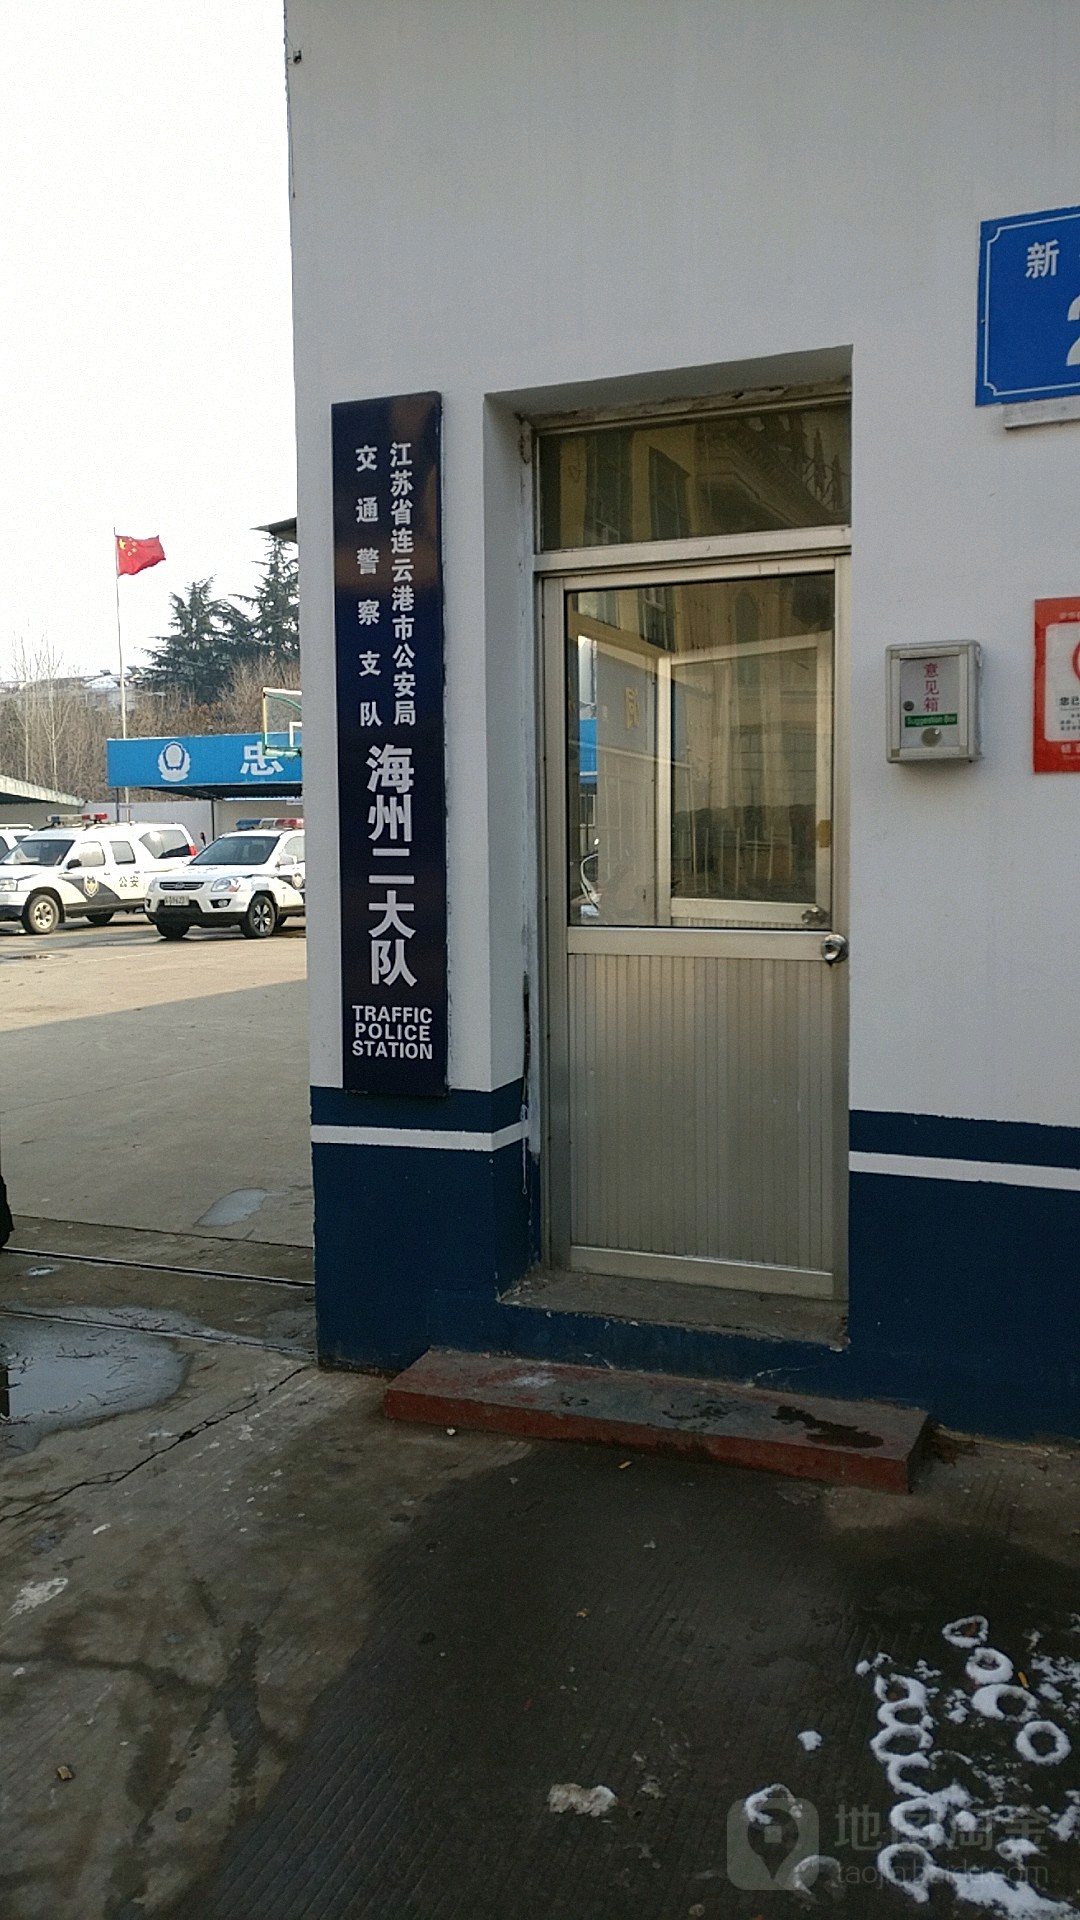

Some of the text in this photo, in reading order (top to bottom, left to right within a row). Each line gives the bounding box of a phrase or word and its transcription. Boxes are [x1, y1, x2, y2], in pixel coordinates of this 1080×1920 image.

[1025, 239, 1060, 279] 新
[355, 445, 383, 728] 交通警察支队
[390, 441, 416, 727] 江苏省连云港市公安局
[923, 662, 940, 713] 意见箱
[240, 741, 284, 776] 忠
[118, 875, 139, 887] 公安
[366, 743, 418, 987] 海州二大队
[351, 1005, 433, 1024] TRAFFIC
[355, 1022, 431, 1041] POLICE
[351, 1040, 433, 1060] STATION
